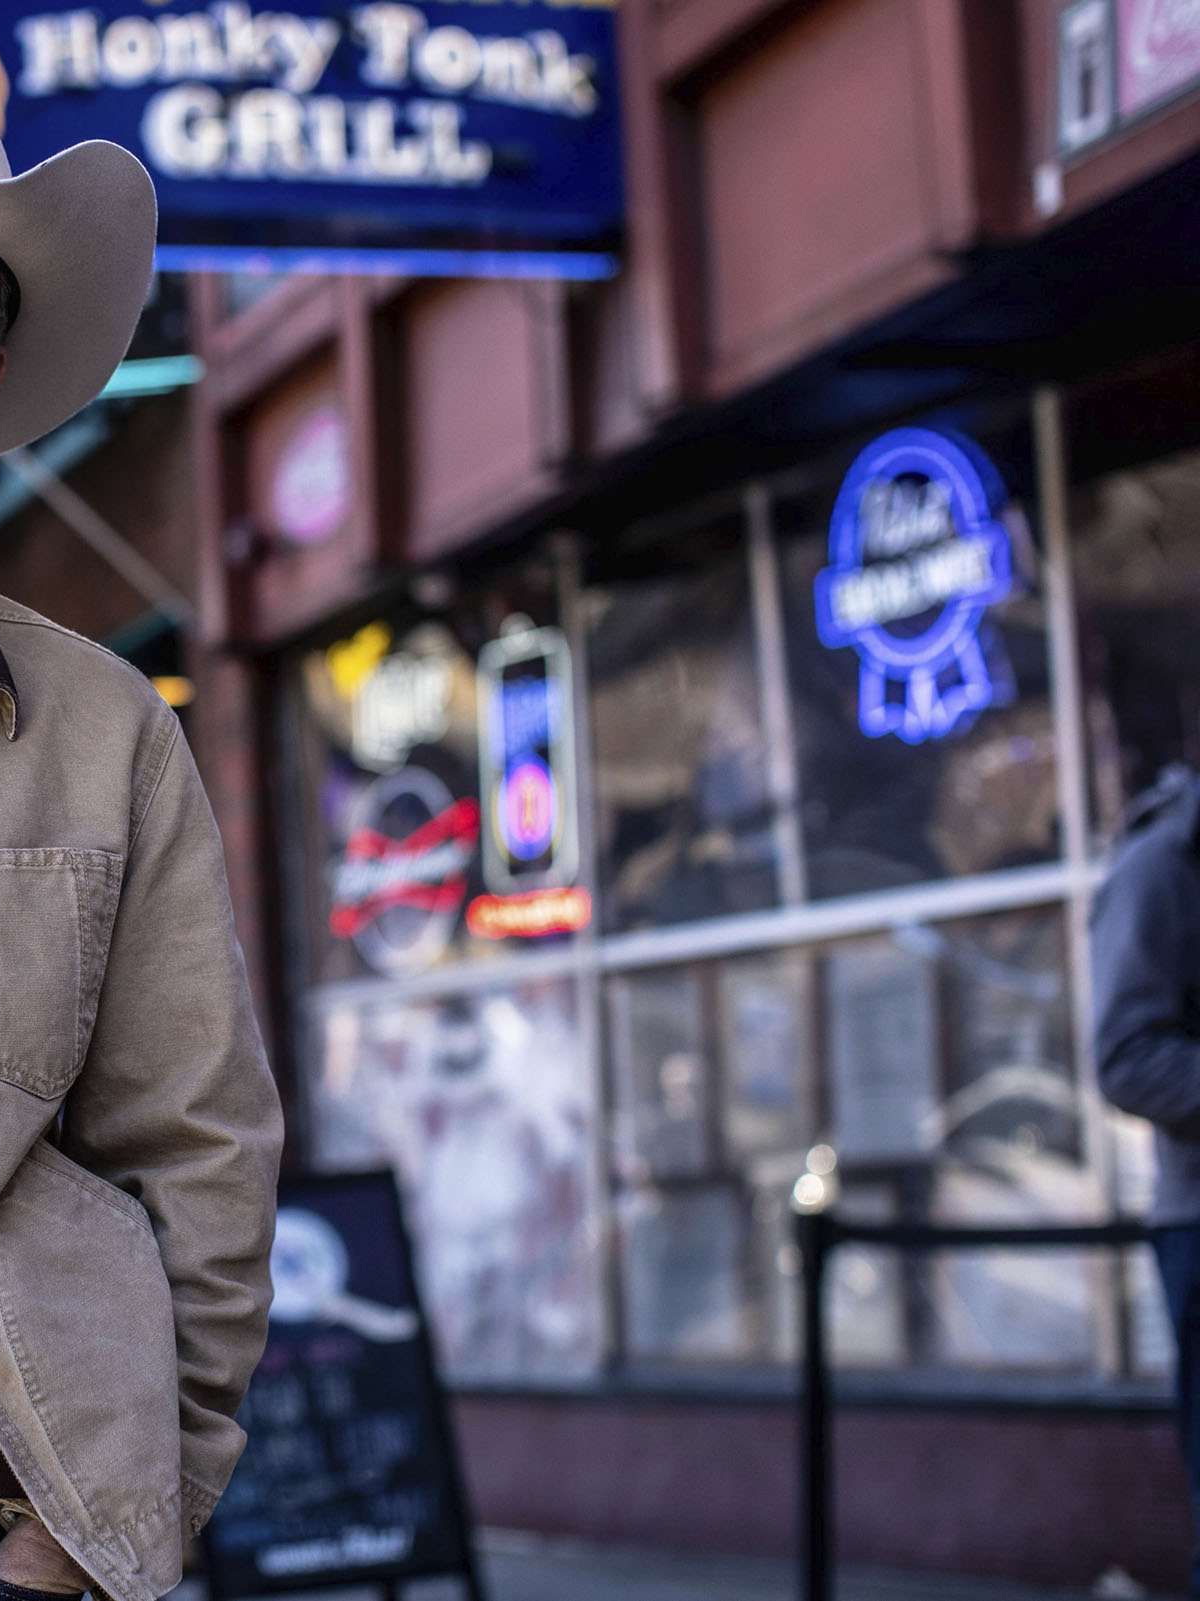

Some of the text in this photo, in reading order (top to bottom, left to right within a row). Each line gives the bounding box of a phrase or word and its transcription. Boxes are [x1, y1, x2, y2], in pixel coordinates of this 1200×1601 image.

[15, 2, 598, 118] Honky Tonk
[141, 84, 490, 185] GRILL
